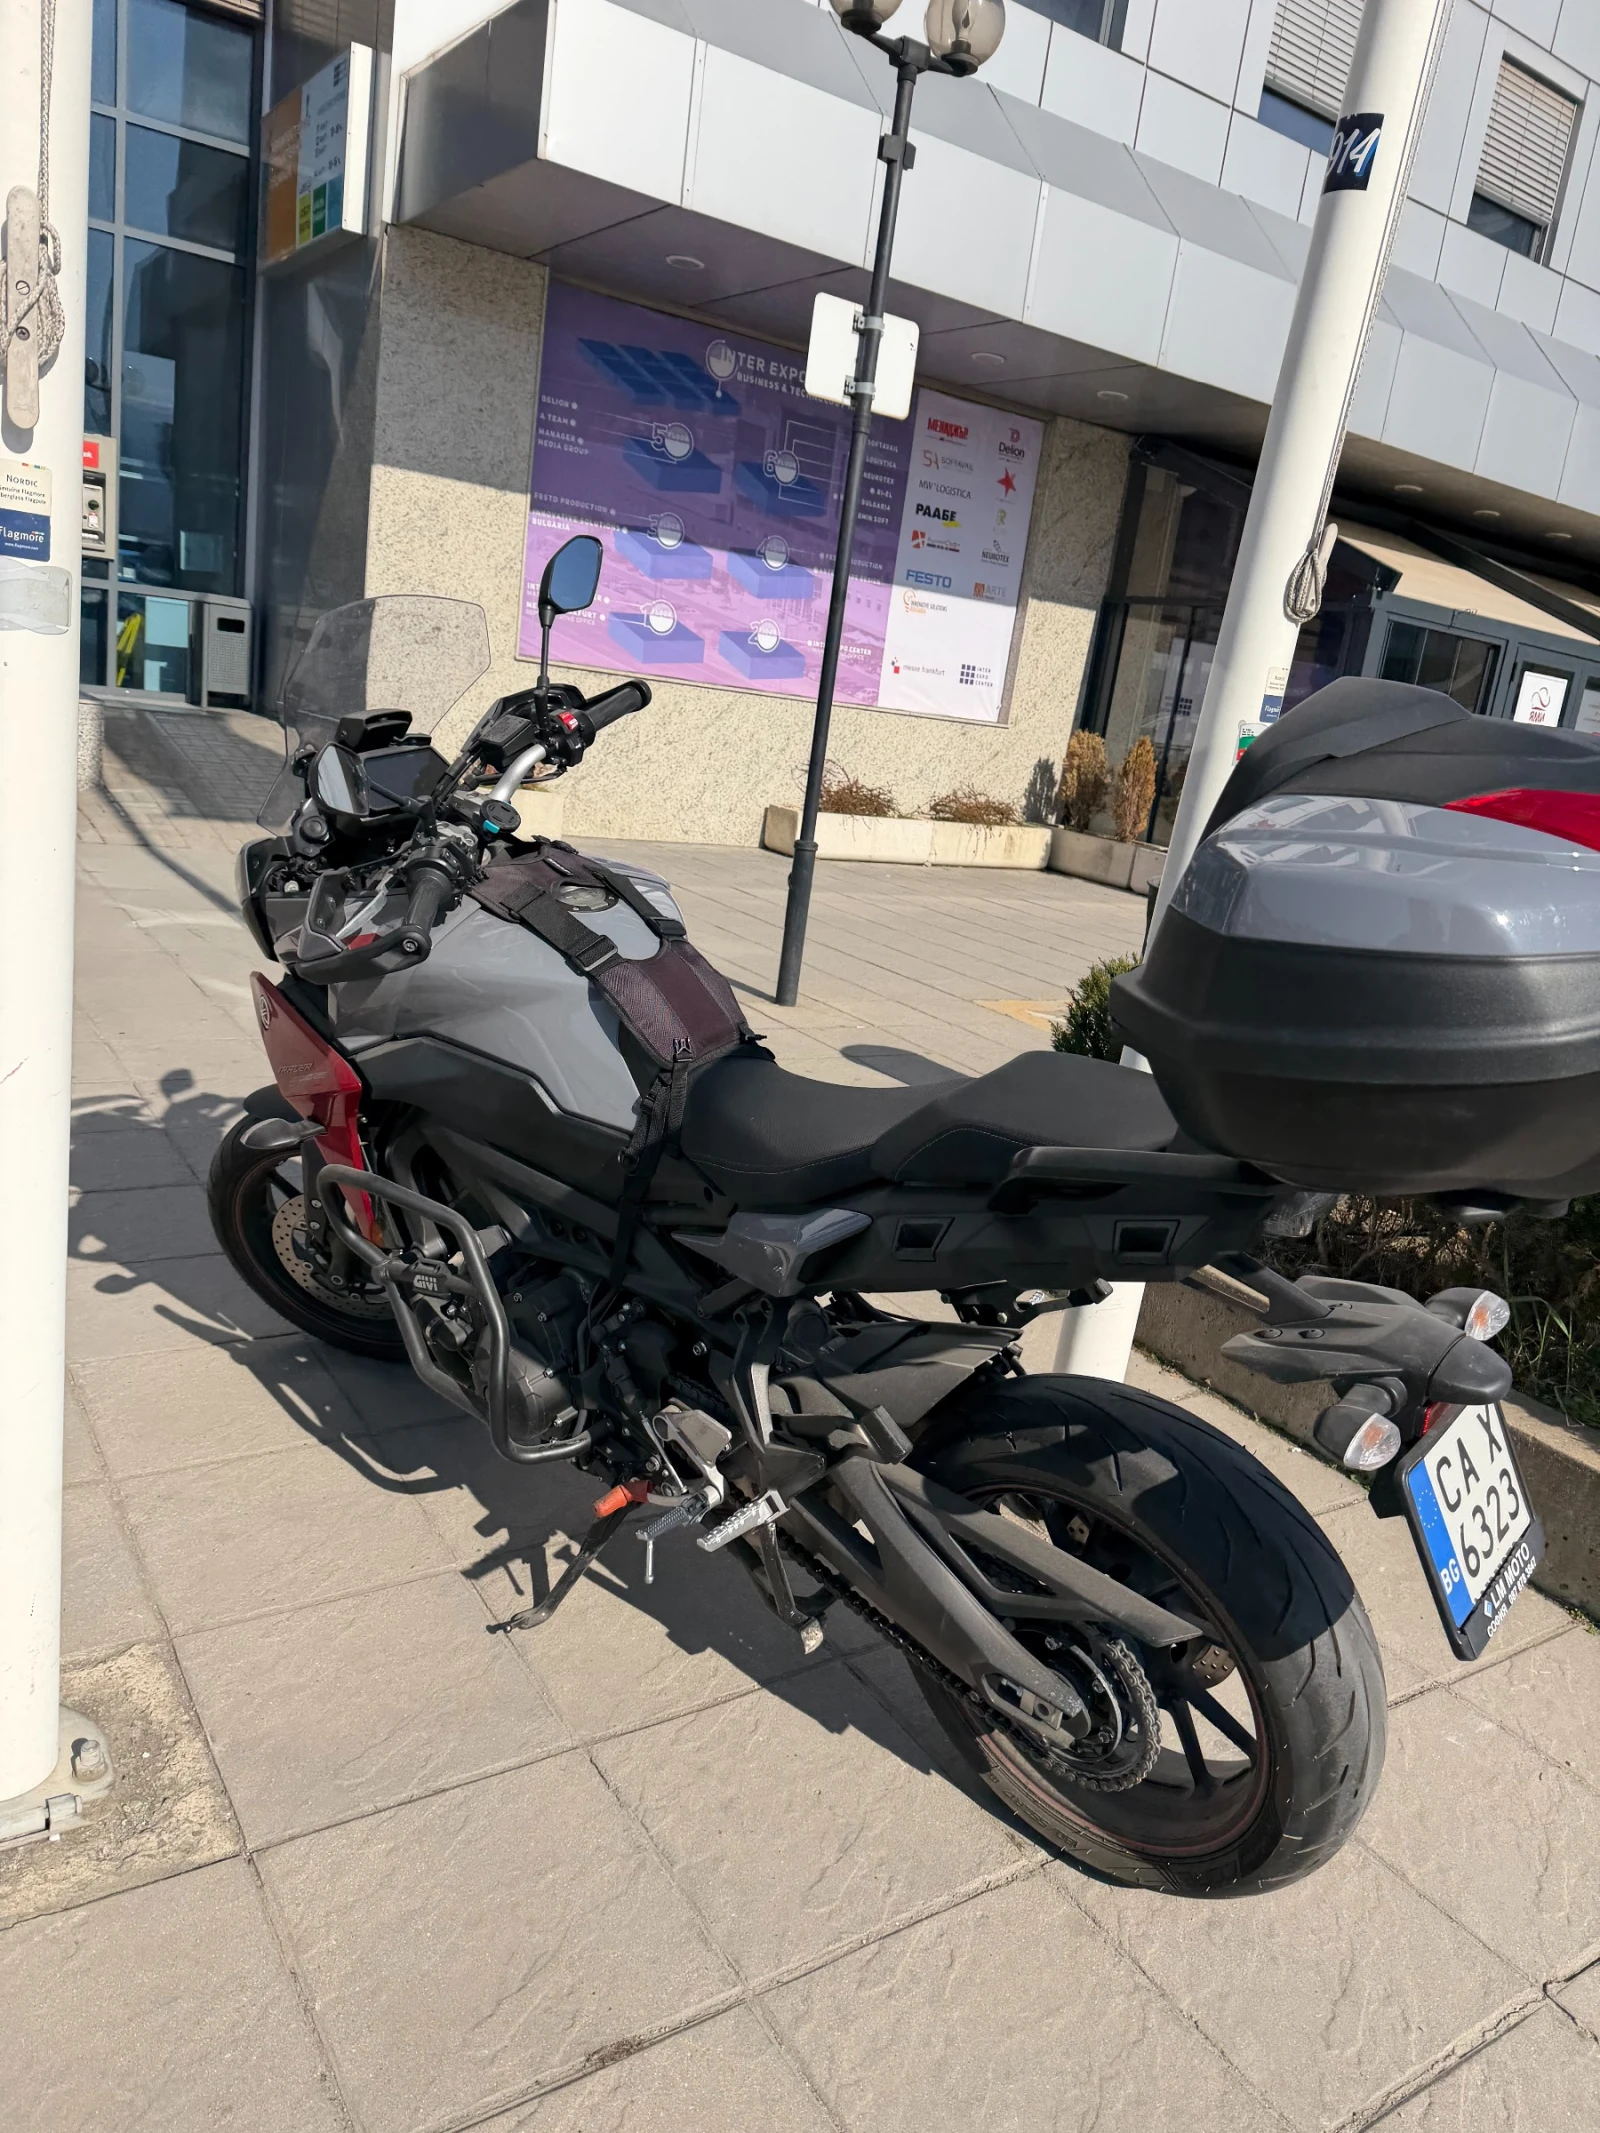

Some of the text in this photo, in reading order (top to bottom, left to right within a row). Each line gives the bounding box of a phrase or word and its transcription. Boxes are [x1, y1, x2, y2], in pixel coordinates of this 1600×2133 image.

[720, 347, 764, 373] INTER
[736, 371, 787, 393] BUSINESS &
[547, 414, 568, 425] TEAM
[538, 427, 576, 443] MANAGER
[651, 422, 668, 451] 5
[537, 438, 589, 456] MEDIA GROUP
[998, 442, 1025, 458] Delion
[762, 450, 778, 478] 6
[6, 474, 39, 487] NORDIC
[560, 498, 608, 513] PRODUCTION
[915, 503, 957, 522] РААБЕ
[531, 518, 570, 531] BULGARIA
[906, 569, 952, 588] FESTO
[413, 1274, 438, 1291] GIVI
[1436, 1404, 1502, 1513] CA X
[1459, 1468, 1520, 1578] 6323
[1440, 1558, 1461, 1596] BG
[1490, 1542, 1530, 1609] LM MOTO
[1487, 1603, 1508, 1638] СОФИЯ
